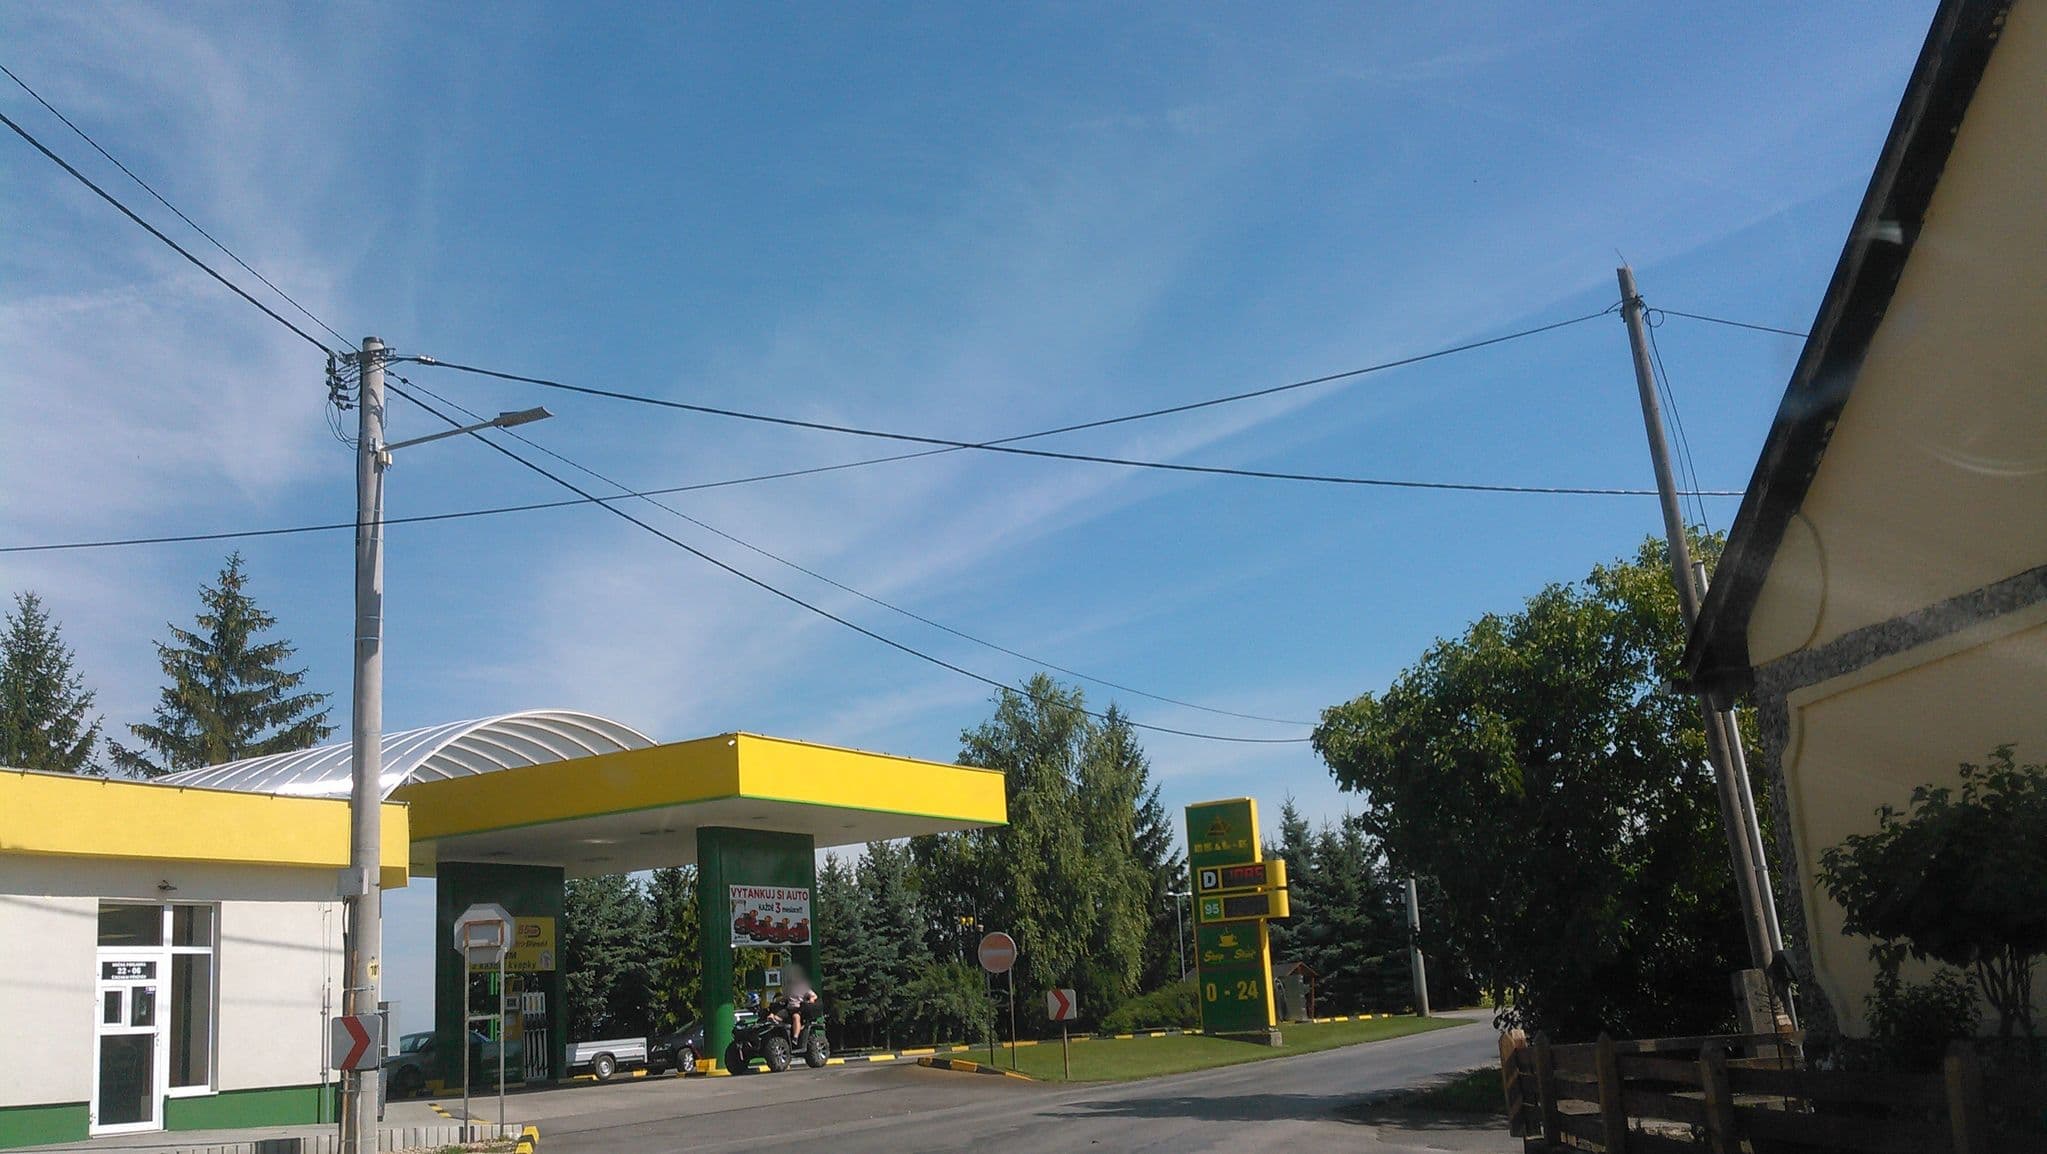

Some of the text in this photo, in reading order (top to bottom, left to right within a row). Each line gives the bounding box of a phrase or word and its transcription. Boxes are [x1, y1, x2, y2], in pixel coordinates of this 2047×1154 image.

[1203, 871, 1217, 888] D
[731, 887, 809, 901] VYTANKUJ SI AUTO
[775, 902, 782, 914] 3
[1204, 903, 1220, 915] 95
[1206, 983, 1217, 1002] 0
[1237, 981, 1258, 1000] 24
